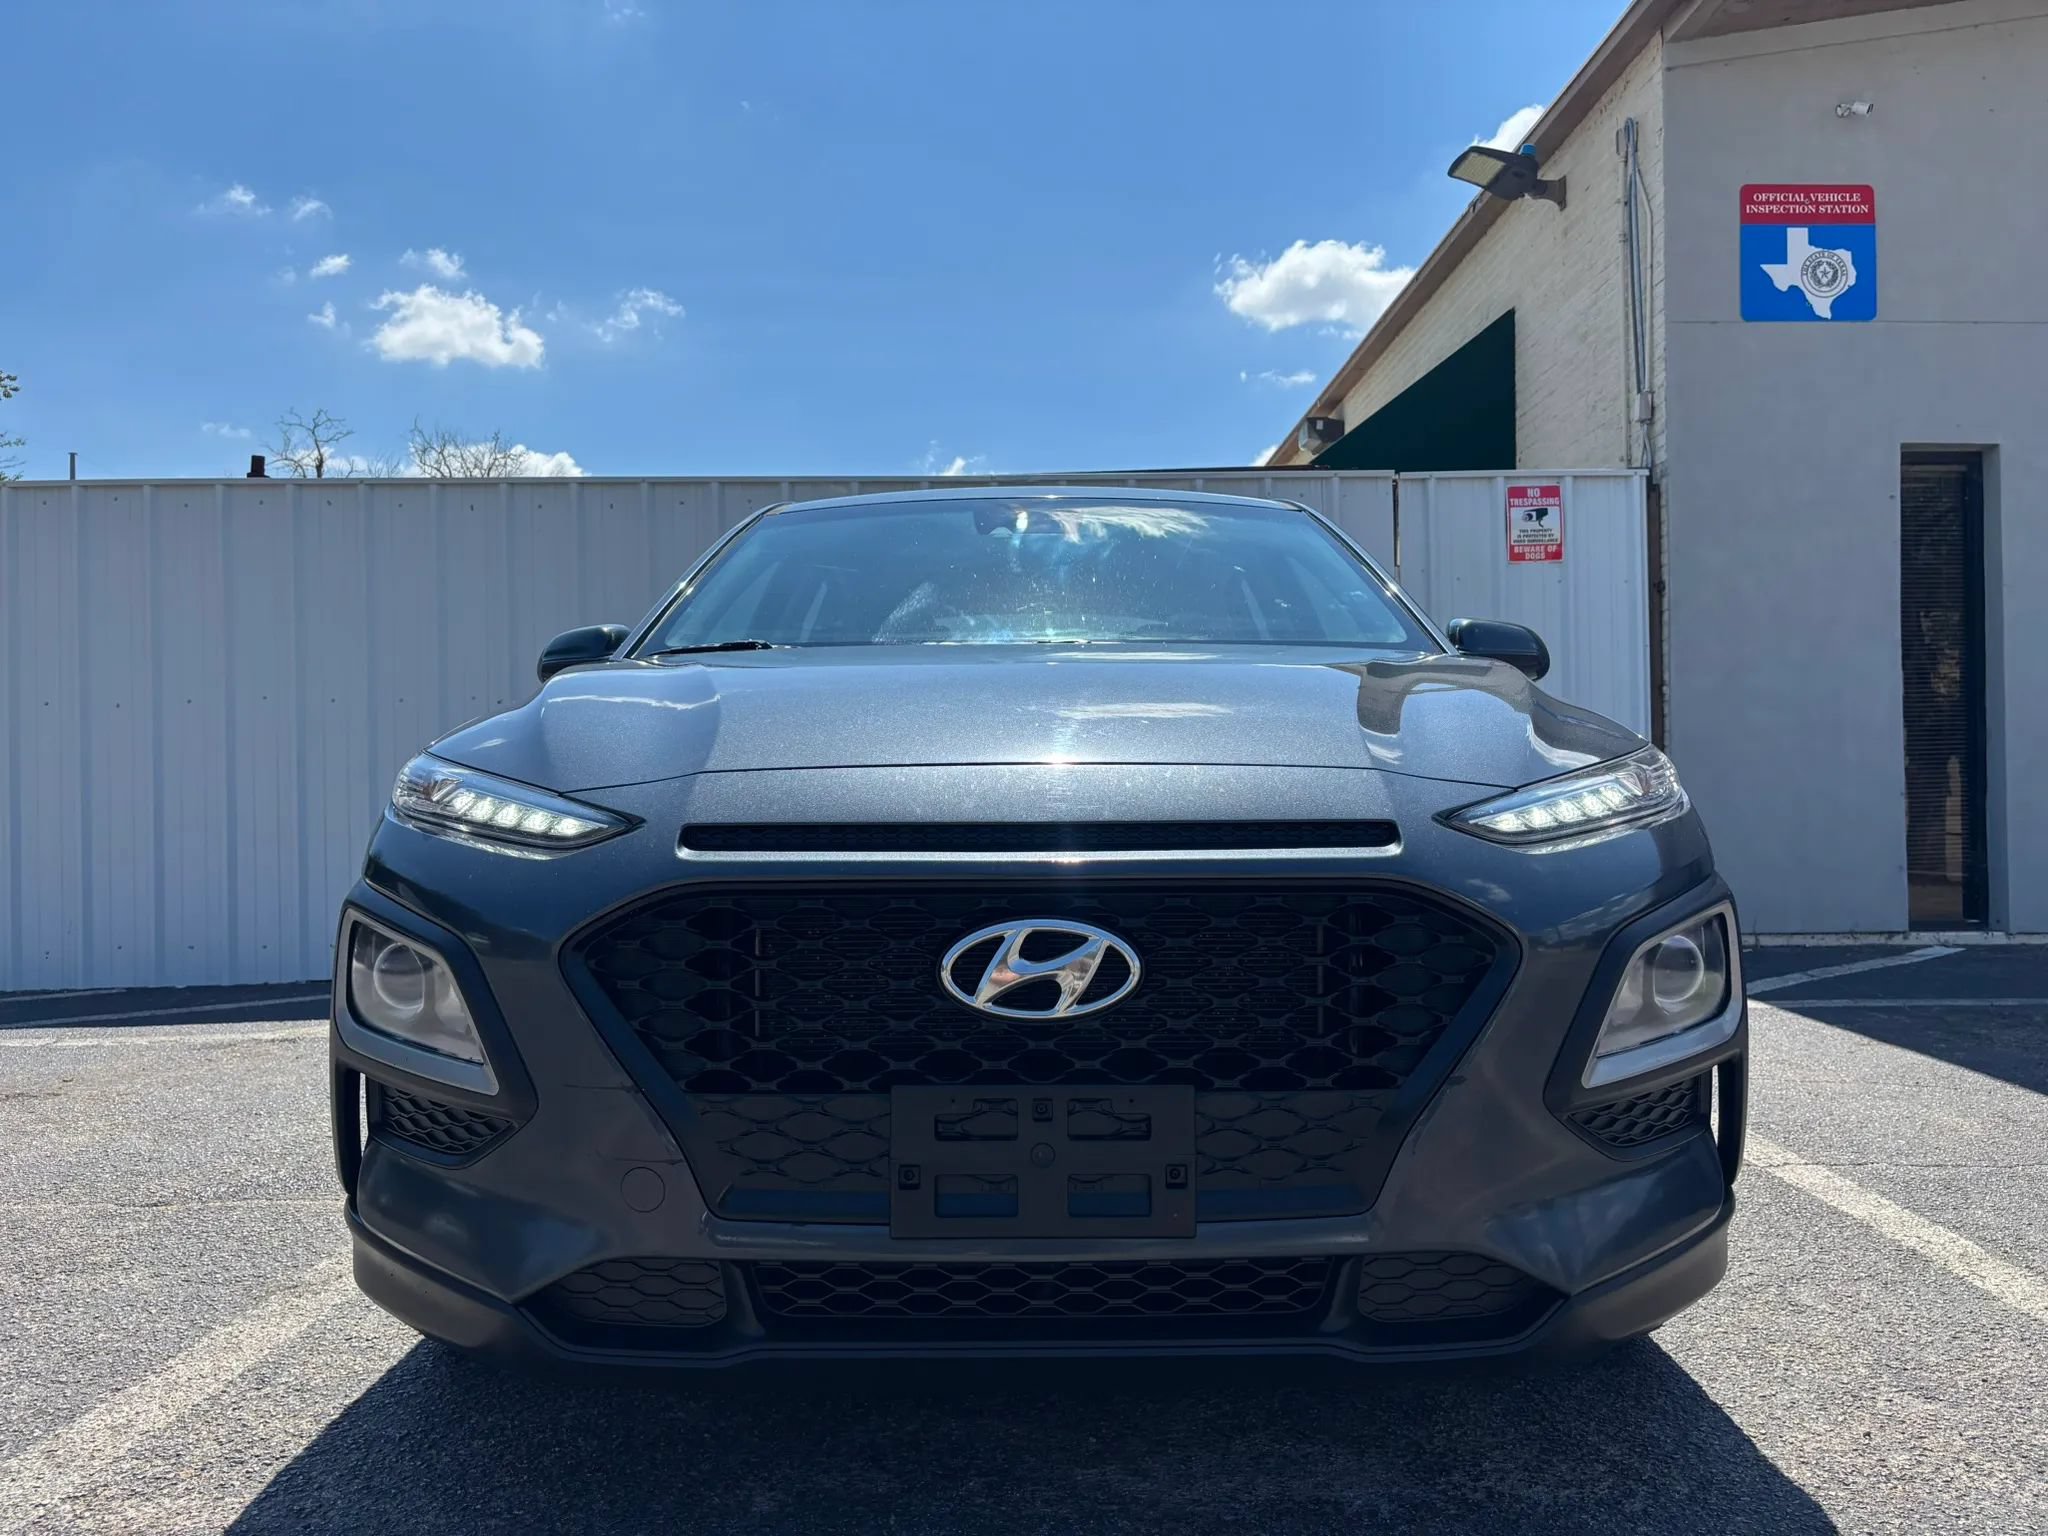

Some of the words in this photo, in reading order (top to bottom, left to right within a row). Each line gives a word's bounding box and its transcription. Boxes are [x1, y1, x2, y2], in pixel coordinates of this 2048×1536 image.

[1753, 192, 1808, 203] OFFICIAL
[1810, 192, 1861, 203] VEHICLE
[1746, 204, 1816, 214] INSPECTION
[1818, 204, 1869, 214] STATION
[1527, 488, 1540, 498] NO
[1509, 497, 1560, 506] TRESPASSING
[1514, 545, 1545, 553] BEWARE
[1525, 552, 1546, 560] DOGS
